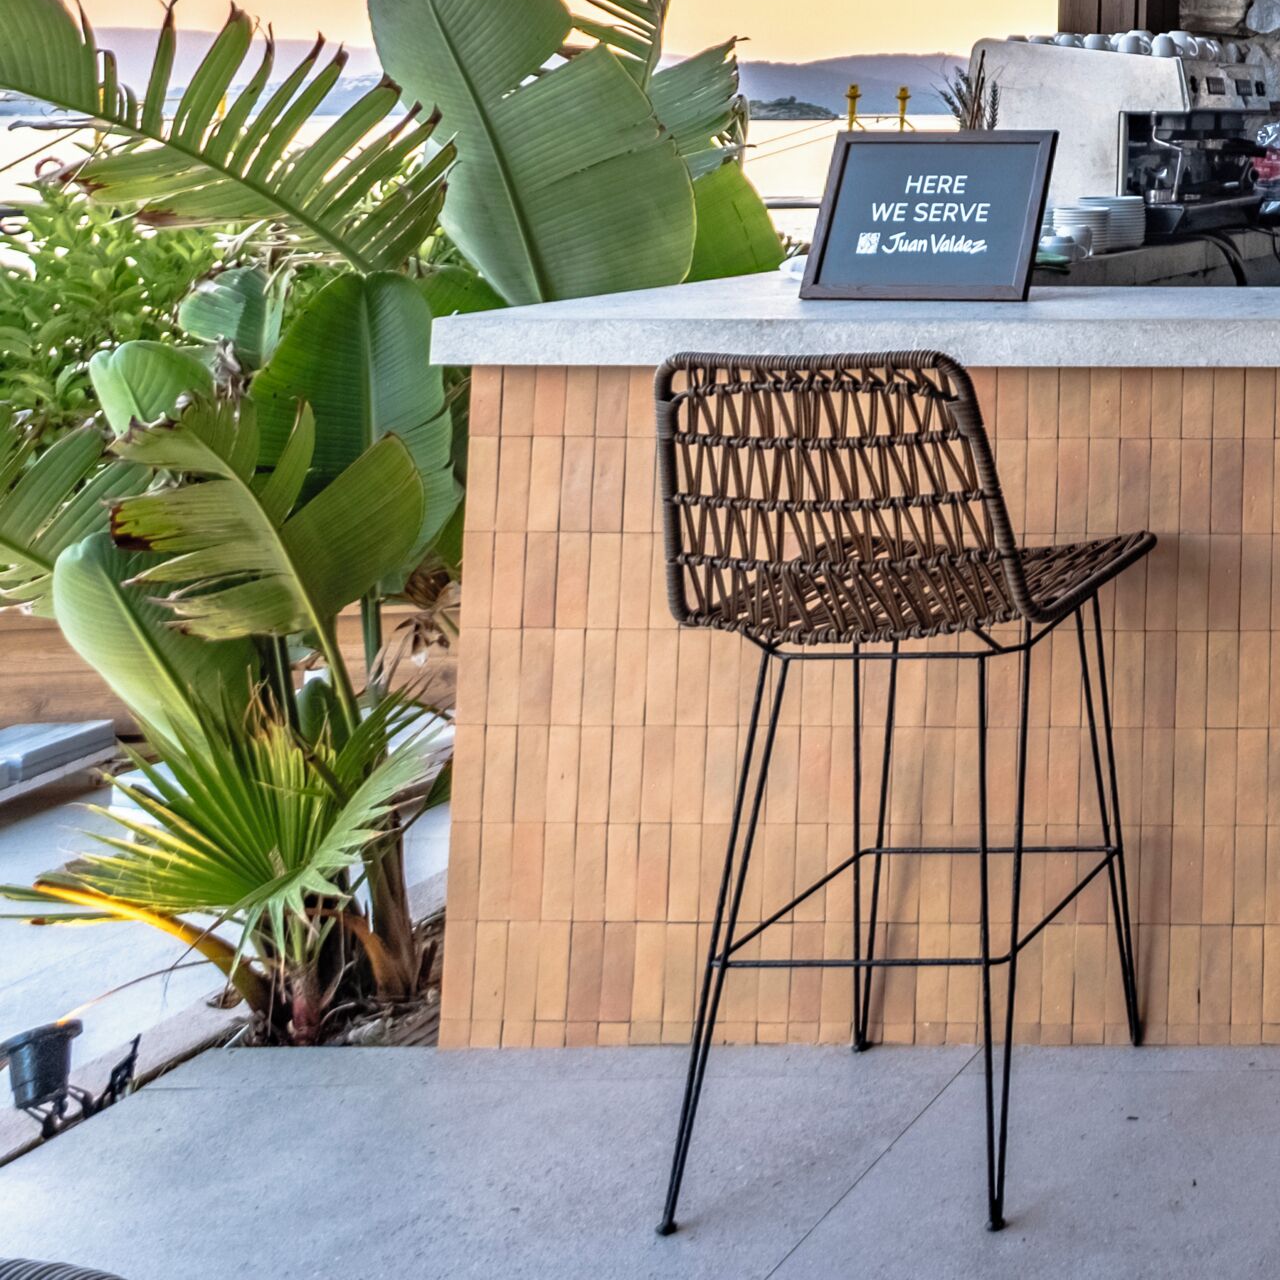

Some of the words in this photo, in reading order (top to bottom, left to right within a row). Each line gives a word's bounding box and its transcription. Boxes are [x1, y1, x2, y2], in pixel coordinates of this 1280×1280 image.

[904, 174, 968, 194] HERE
[871, 202, 907, 222] WE
[913, 202, 991, 223] SERVE
[881, 231, 928, 254] Juan
[930, 233, 988, 255] Valdez
